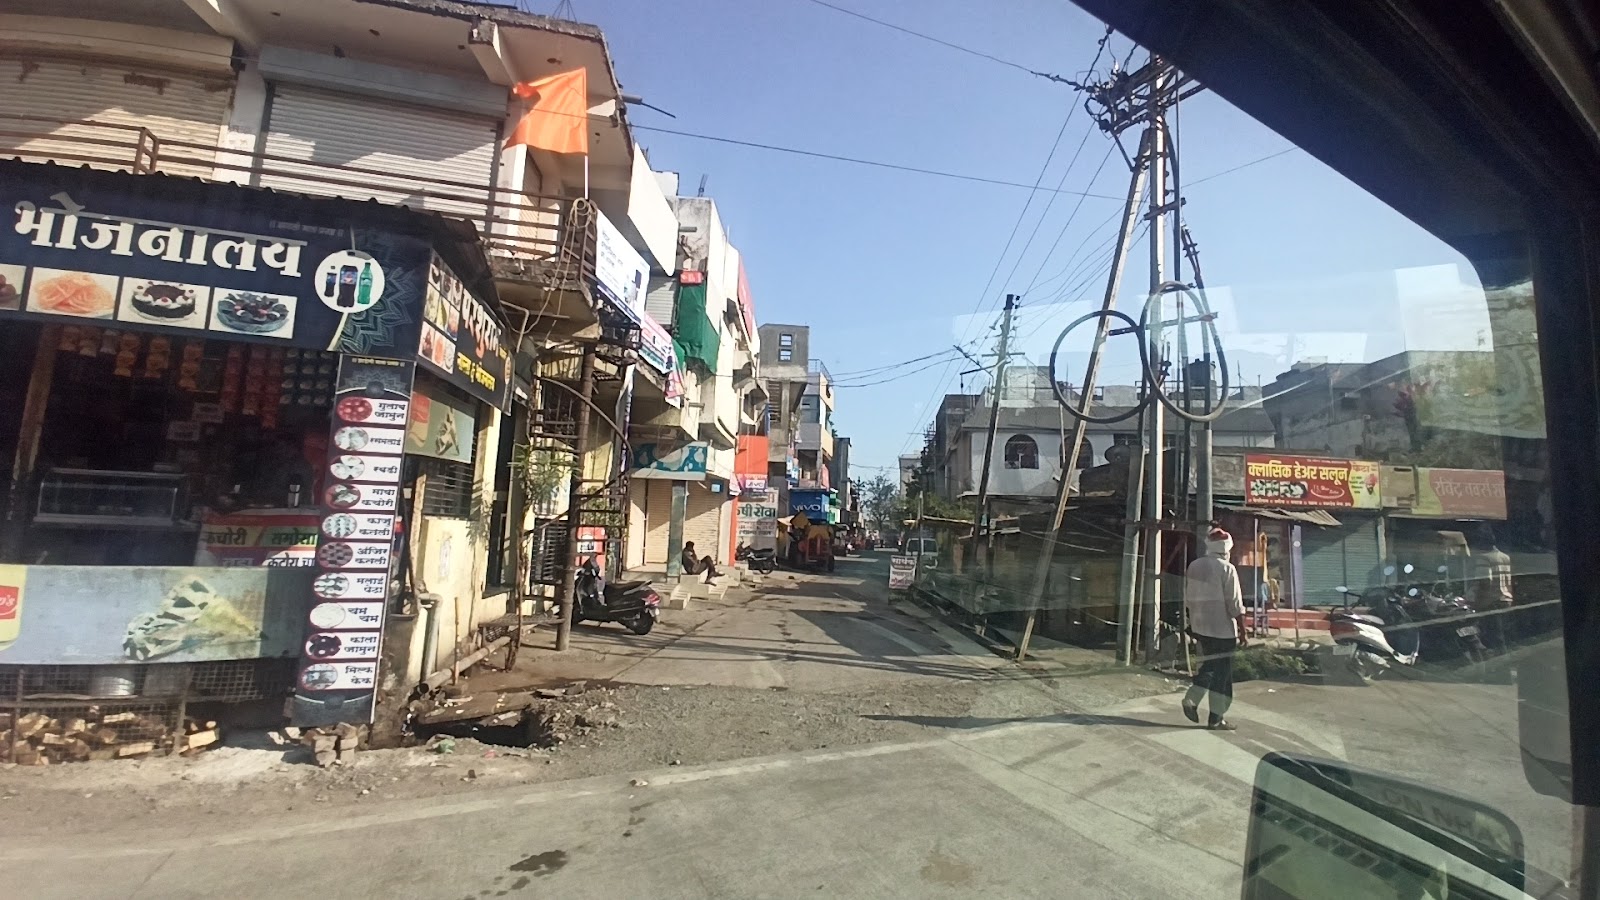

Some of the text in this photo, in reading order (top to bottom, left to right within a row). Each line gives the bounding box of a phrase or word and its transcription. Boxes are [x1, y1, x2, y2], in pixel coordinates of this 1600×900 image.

[14, 191, 308, 278] भोजनालय
[374, 411, 405, 421] जामुन
[1247, 459, 1292, 479] क्लासिक
[1293, 462, 1318, 480] हेअर
[1318, 465, 1349, 485] सलून
[361, 498, 394, 507] कचोरी
[753, 503, 776, 518] सेवा
[356, 576, 384, 584] मलाई
[350, 636, 377, 644] काला
[344, 646, 376, 655] जामुन
[350, 676, 372, 684] केक
